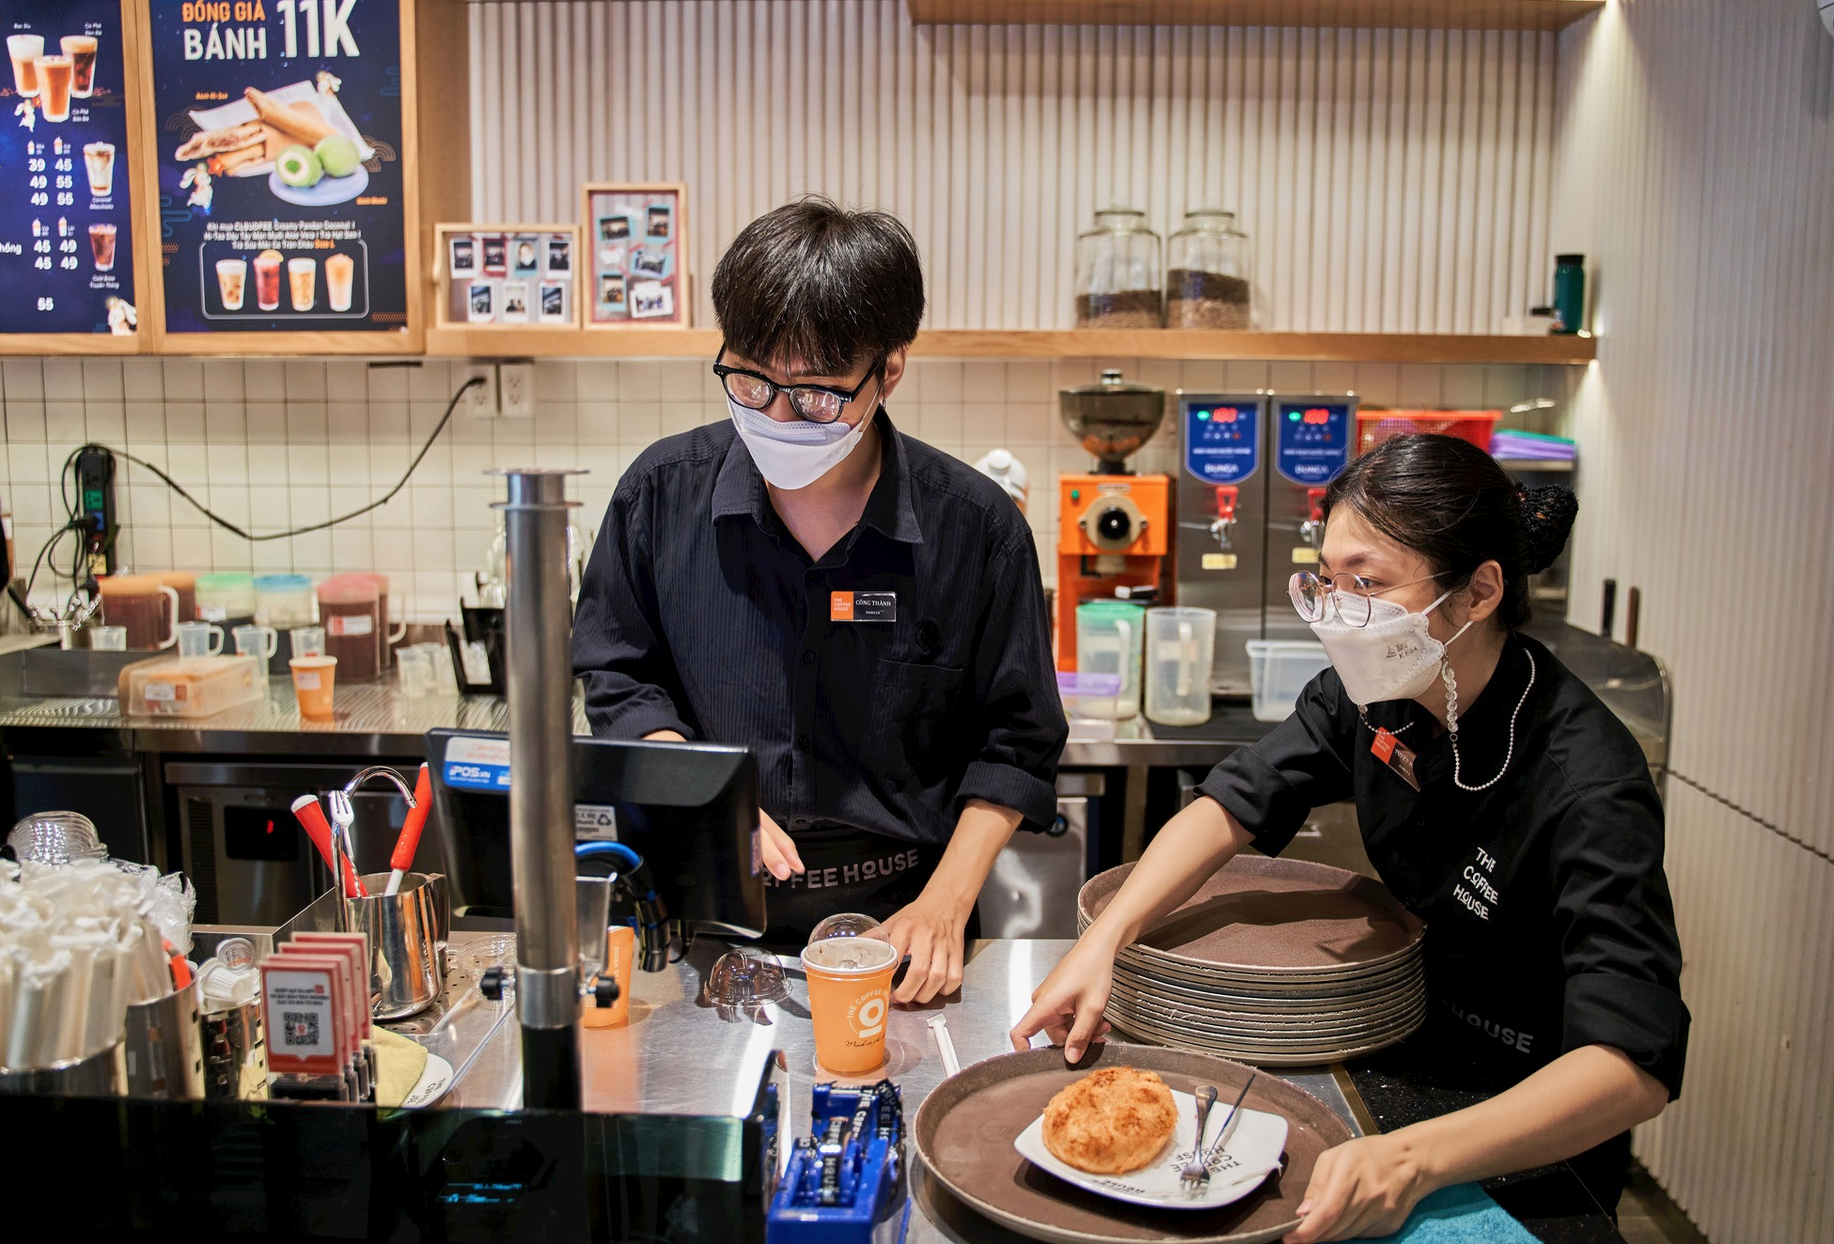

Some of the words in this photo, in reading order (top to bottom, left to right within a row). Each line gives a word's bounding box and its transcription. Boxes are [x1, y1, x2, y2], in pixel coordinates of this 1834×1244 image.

[183, 22, 267, 61] BÁNH
[277, 0, 361, 58] 11K
[28, 158, 46, 172] 39
[54, 158, 73, 172] 45
[29, 175, 48, 189] 49
[55, 175, 73, 189] 55
[30, 192, 48, 206] 49
[57, 192, 74, 206] 55
[33, 239, 51, 253] 45
[59, 239, 77, 253] 49
[34, 256, 52, 270] 45
[60, 256, 78, 270] 49
[37, 296, 54, 311] 55
[843, 848, 920, 885] HOUSE
[1475, 846, 1497, 873] THE
[1463, 866, 1499, 905] COFFEE
[1453, 884, 1490, 921] HOUSE
[846, 1004, 857, 1019] THE
[855, 988, 883, 1005] COFFEE
